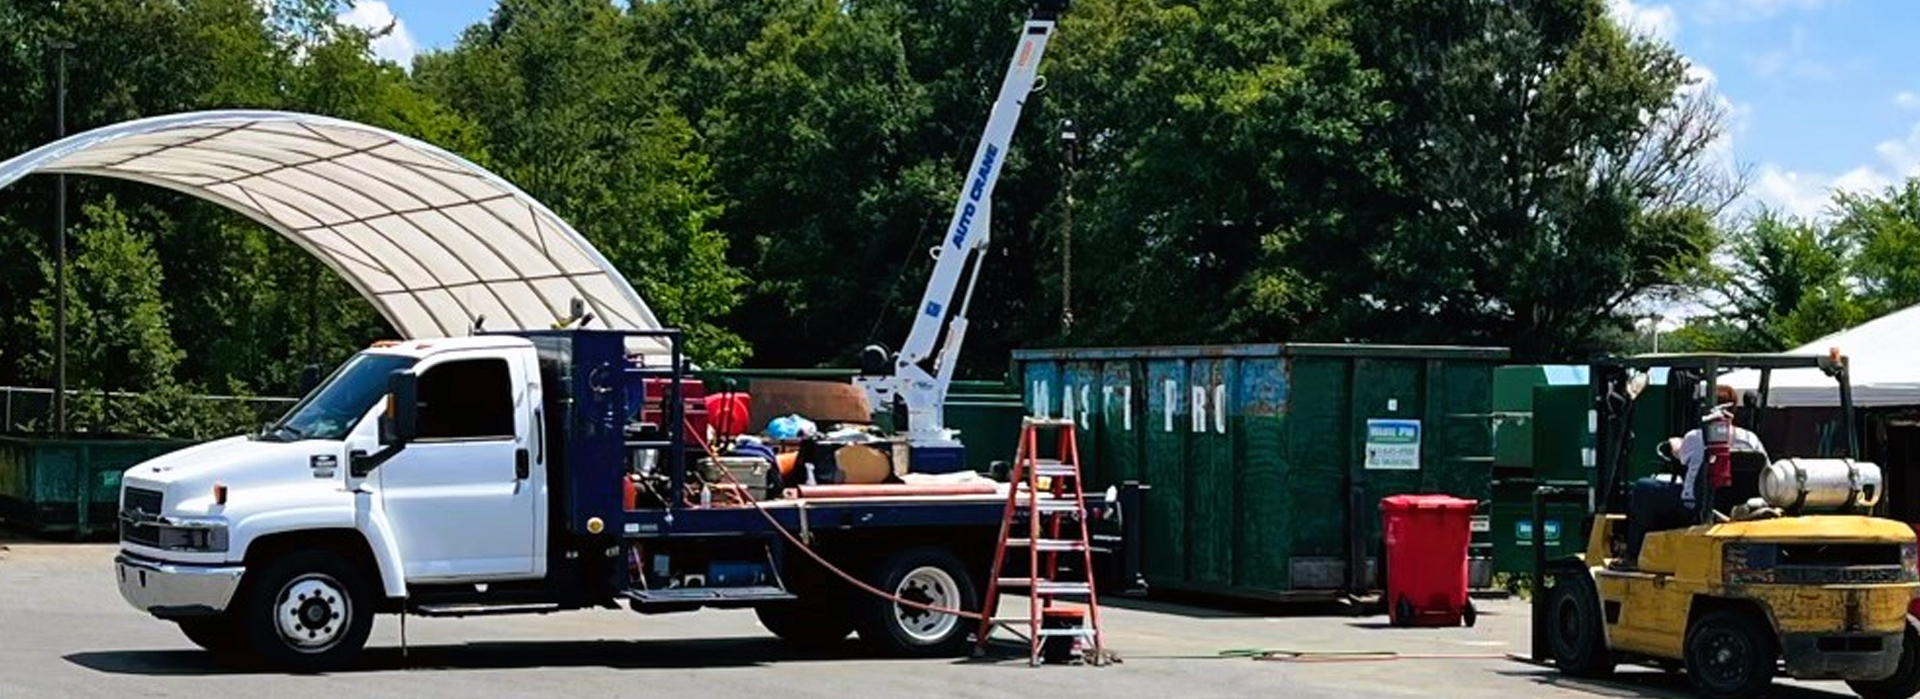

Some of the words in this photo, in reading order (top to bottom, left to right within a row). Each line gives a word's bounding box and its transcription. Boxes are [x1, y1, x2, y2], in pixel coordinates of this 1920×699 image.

[952, 202, 976, 250] AUTO
[970, 142, 999, 202] CRANE
[1164, 379, 1226, 434] PRO
